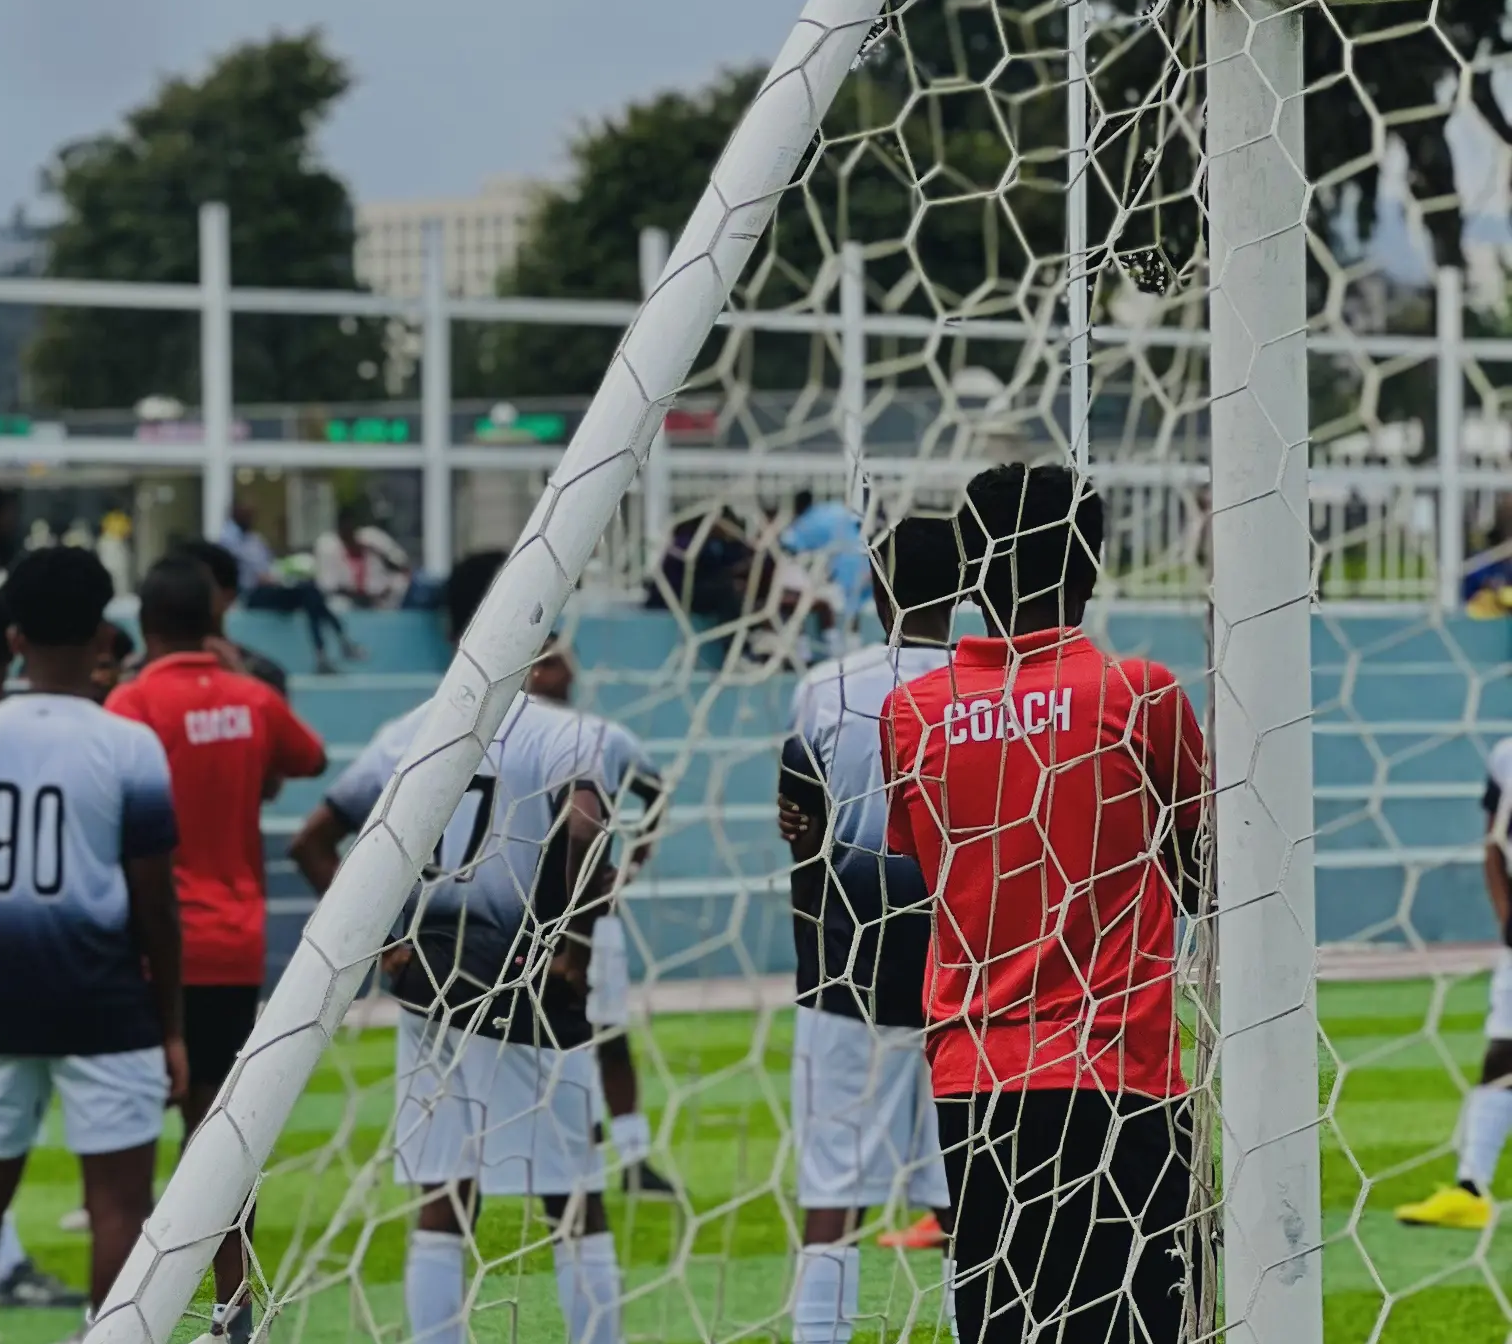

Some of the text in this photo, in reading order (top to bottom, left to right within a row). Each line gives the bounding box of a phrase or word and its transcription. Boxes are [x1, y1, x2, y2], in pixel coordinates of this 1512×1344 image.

[184, 705, 252, 744] COACH
[944, 687, 1073, 745] COACH
[430, 774, 498, 884] 7
